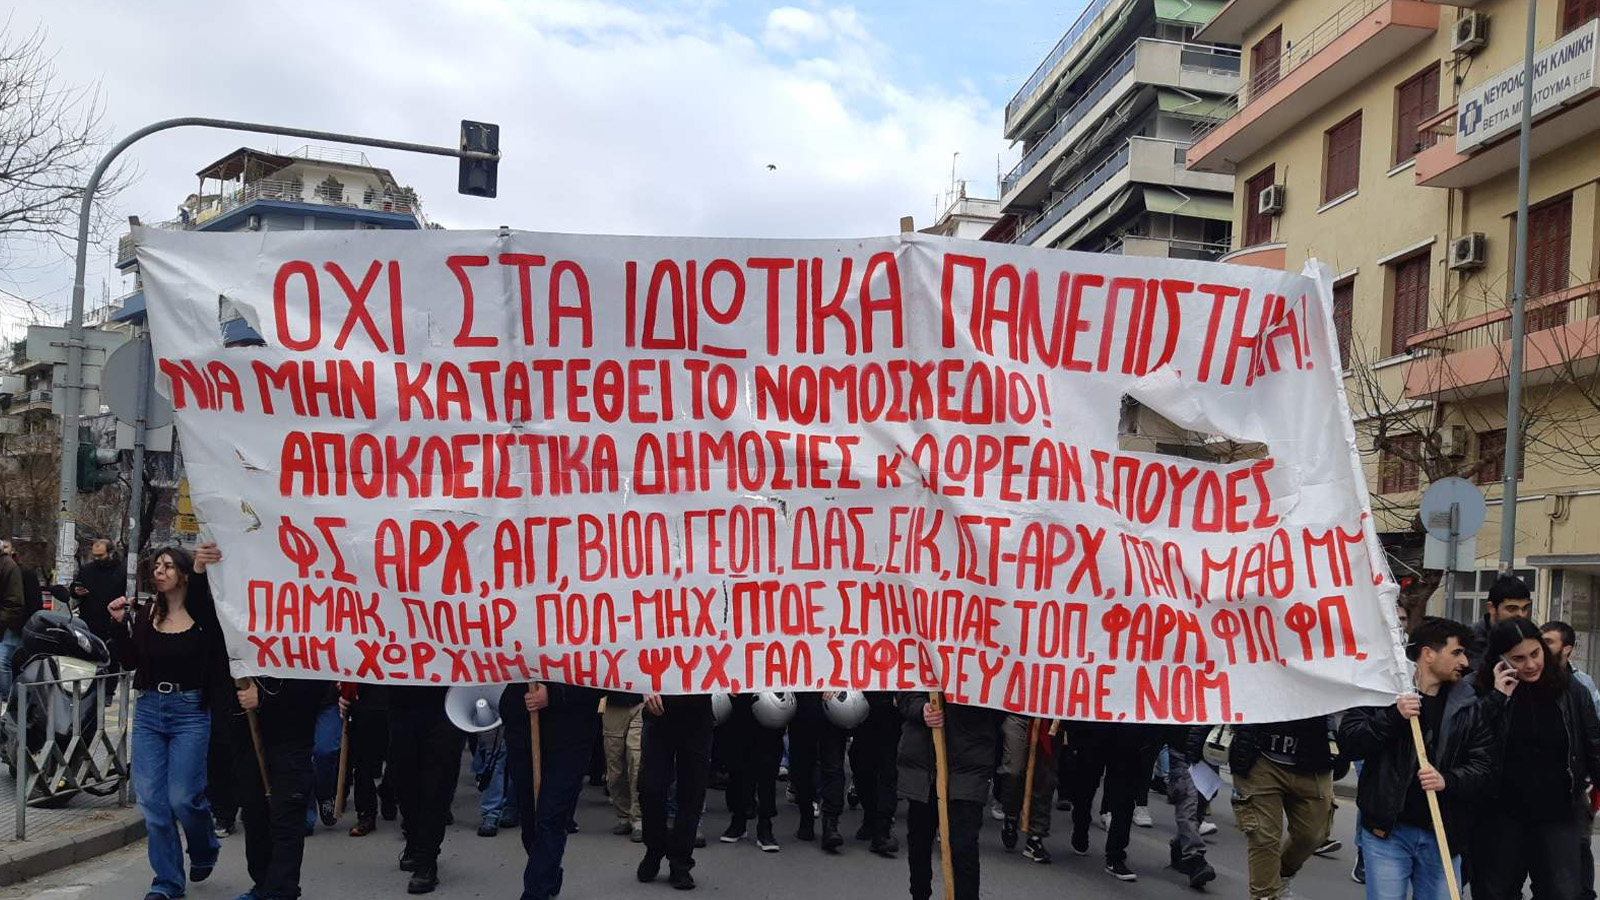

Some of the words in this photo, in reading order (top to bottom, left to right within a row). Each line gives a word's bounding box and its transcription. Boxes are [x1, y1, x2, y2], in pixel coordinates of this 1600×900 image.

[1550, 32, 1593, 72] ΚΛΙΝΙΚΗ
[1483, 108, 1509, 131] ΒΕΤΤΑ
[273, 259, 406, 355] ΟΧΙ
[446, 253, 593, 348] ΣΤΑ
[251, 360, 376, 420] ΜΗΝ
[395, 359, 673, 423] ΚΑΤΑΤΕΘΕΙ
[683, 359, 738, 421] ΤΟ
[755, 359, 1052, 429] ΝΟΜΟΣΧΕΔΙΟ!
[279, 431, 619, 499] ΑΠΟΚΛΕΙΣΤΙΚΑ
[633, 430, 862, 495] ΔΗΜΟΣΙΕΣ
[1090, 449, 1280, 534] ΣΠΟΥΔΕΣ
